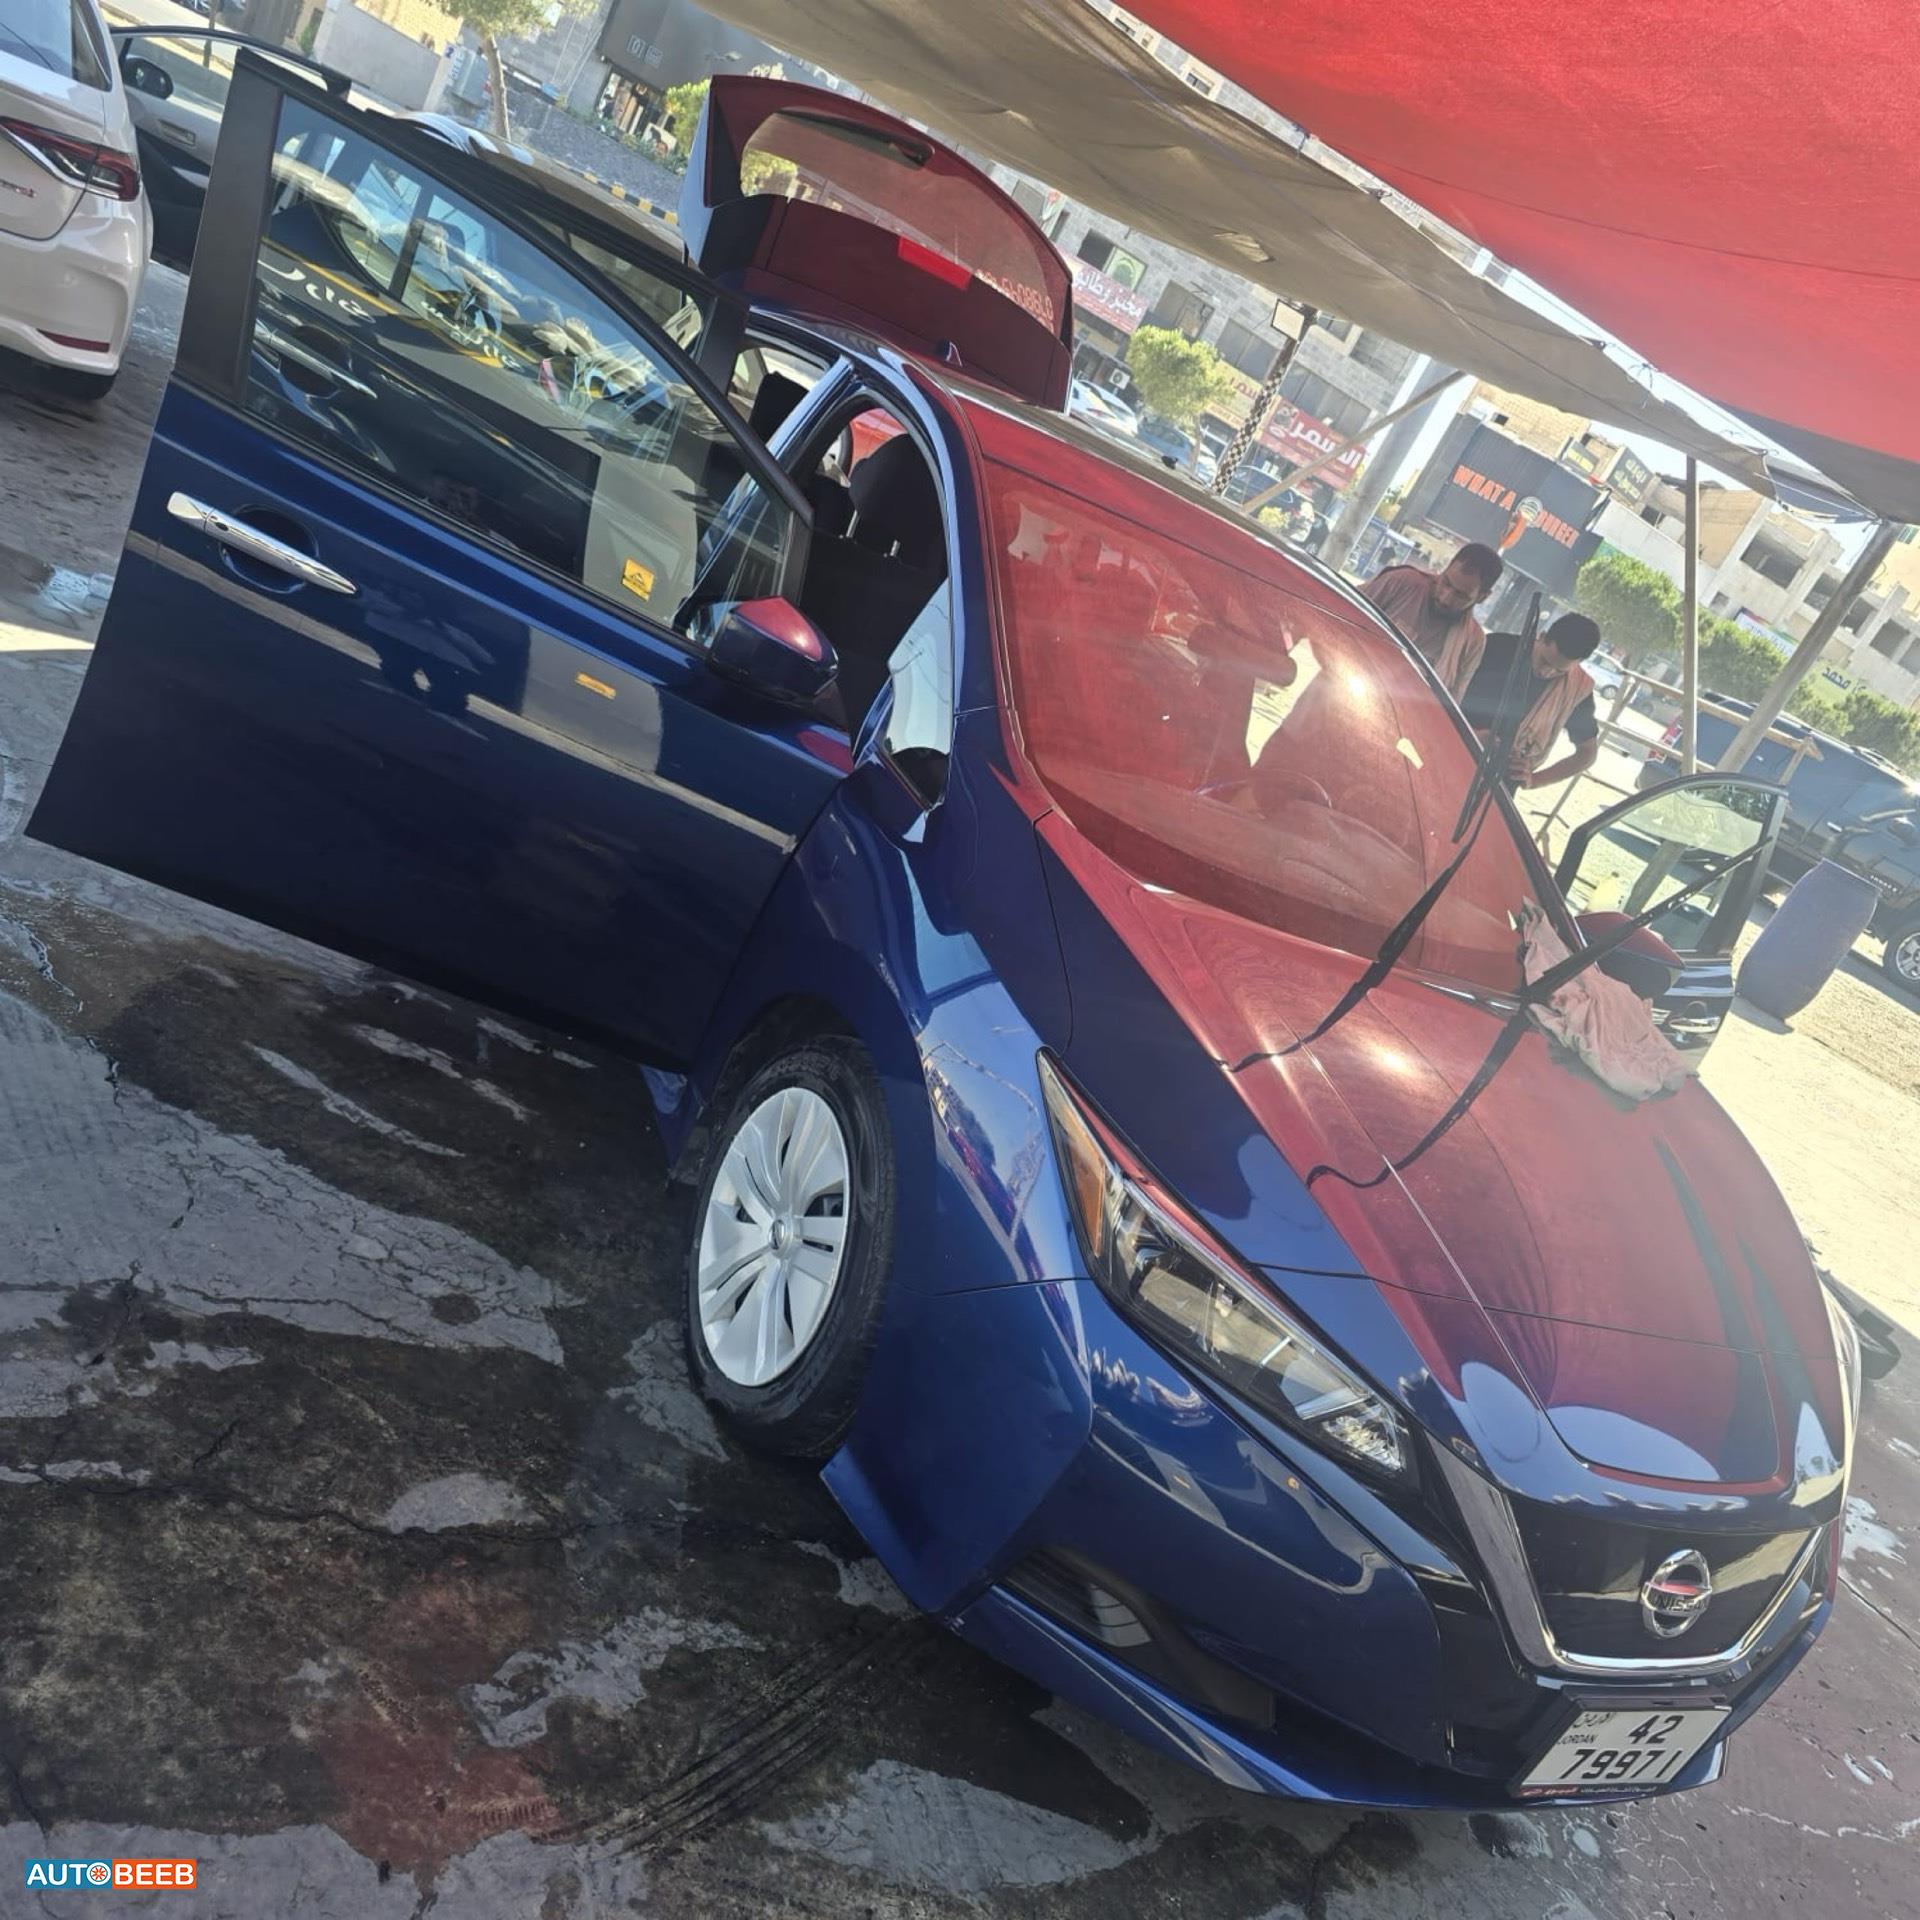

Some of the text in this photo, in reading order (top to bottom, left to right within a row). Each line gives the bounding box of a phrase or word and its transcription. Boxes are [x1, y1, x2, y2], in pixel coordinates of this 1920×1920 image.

[1452, 464, 1580, 550] WHAT A BURGER
[1558, 1733, 1599, 1745] JORDAN
[1627, 1714, 1685, 1745] 42
[1558, 1748, 1683, 1780] 79971
